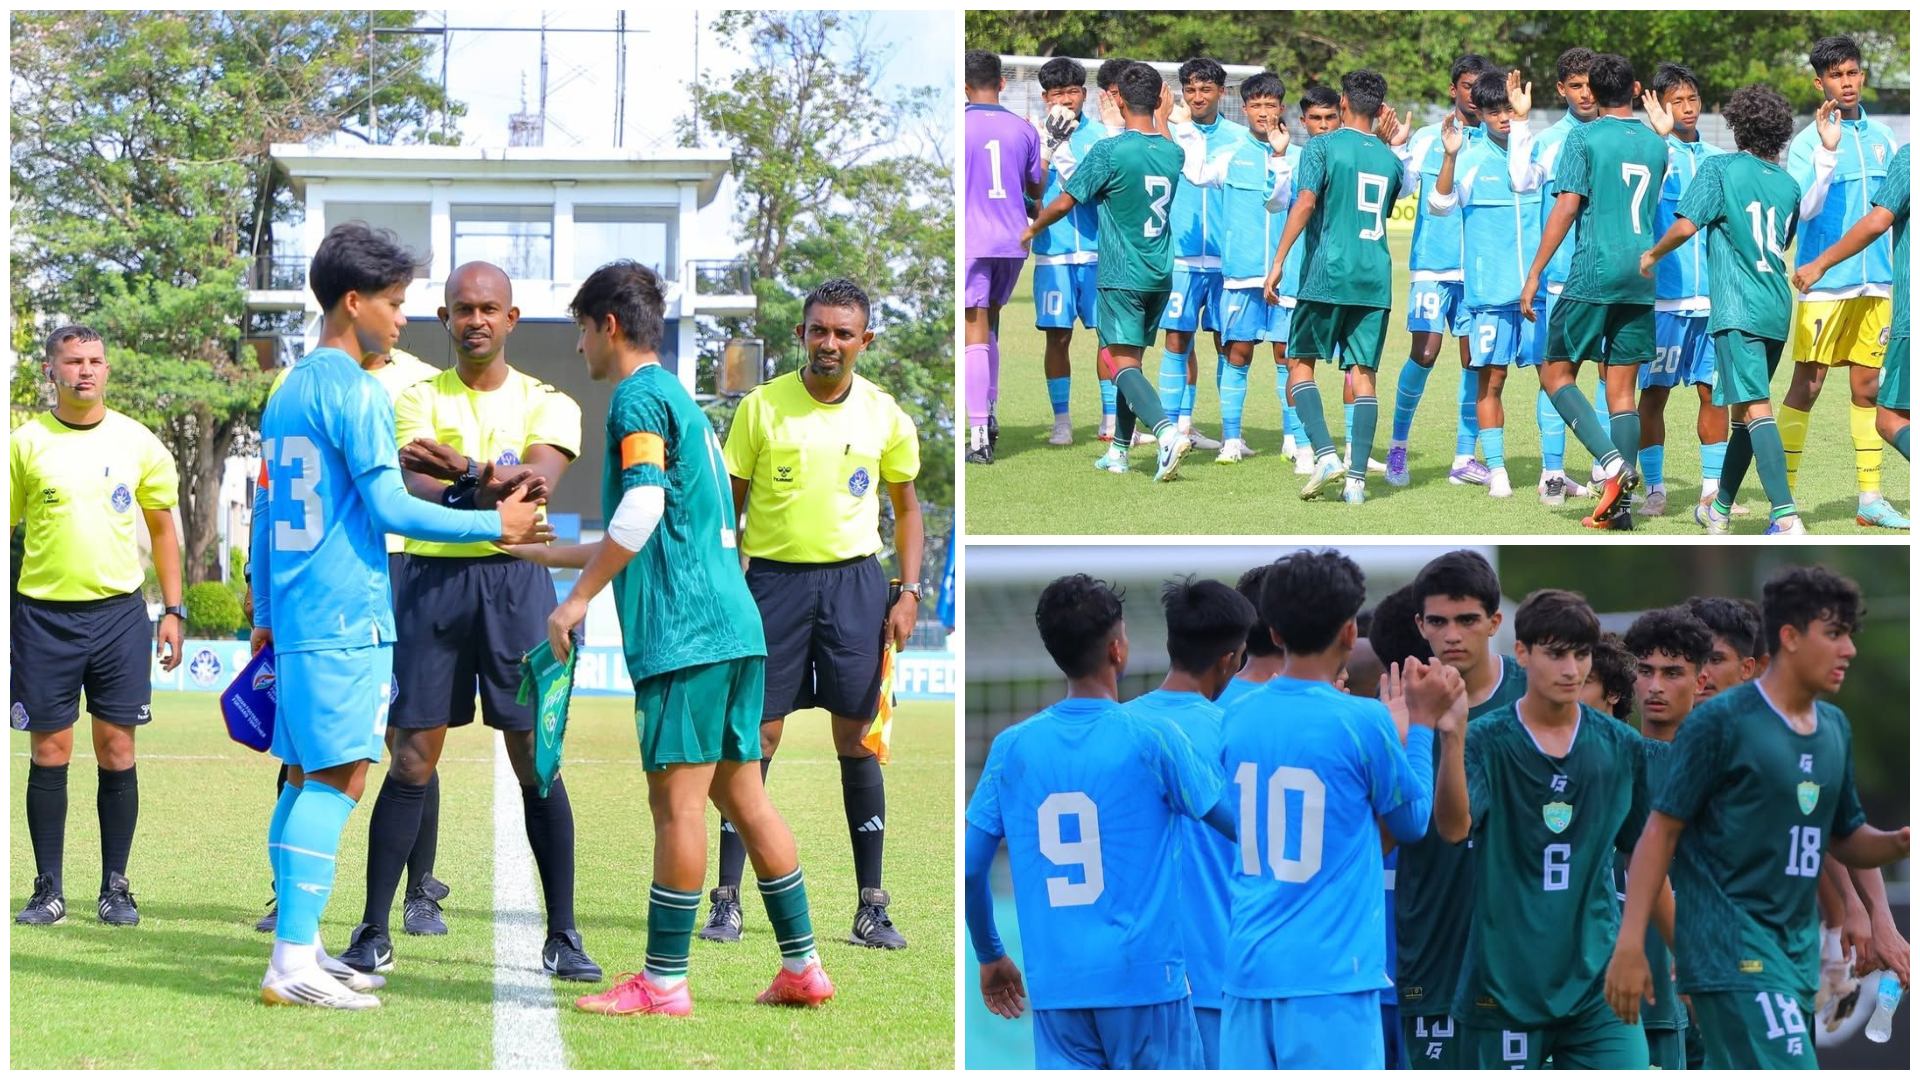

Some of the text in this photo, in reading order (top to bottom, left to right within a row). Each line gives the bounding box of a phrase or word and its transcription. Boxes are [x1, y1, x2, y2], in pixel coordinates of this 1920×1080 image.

[984, 139, 1007, 199] 1
[1144, 175, 1172, 237] 3
[1357, 171, 1389, 241] 9
[1621, 162, 1651, 234] 7
[1745, 200, 1790, 276] 14
[1042, 290, 1063, 316] 10
[1168, 292, 1184, 318] 3
[1414, 291, 1440, 320] 19
[1478, 324, 1497, 354] 2
[1812, 318, 1823, 346] 1
[1650, 345, 1682, 374] 20
[1233, 761, 1326, 884] 10
[1037, 791, 1105, 908] 9
[1543, 843, 1572, 891] 6
[1785, 825, 1821, 878] 18
[1755, 991, 1807, 1040] 18
